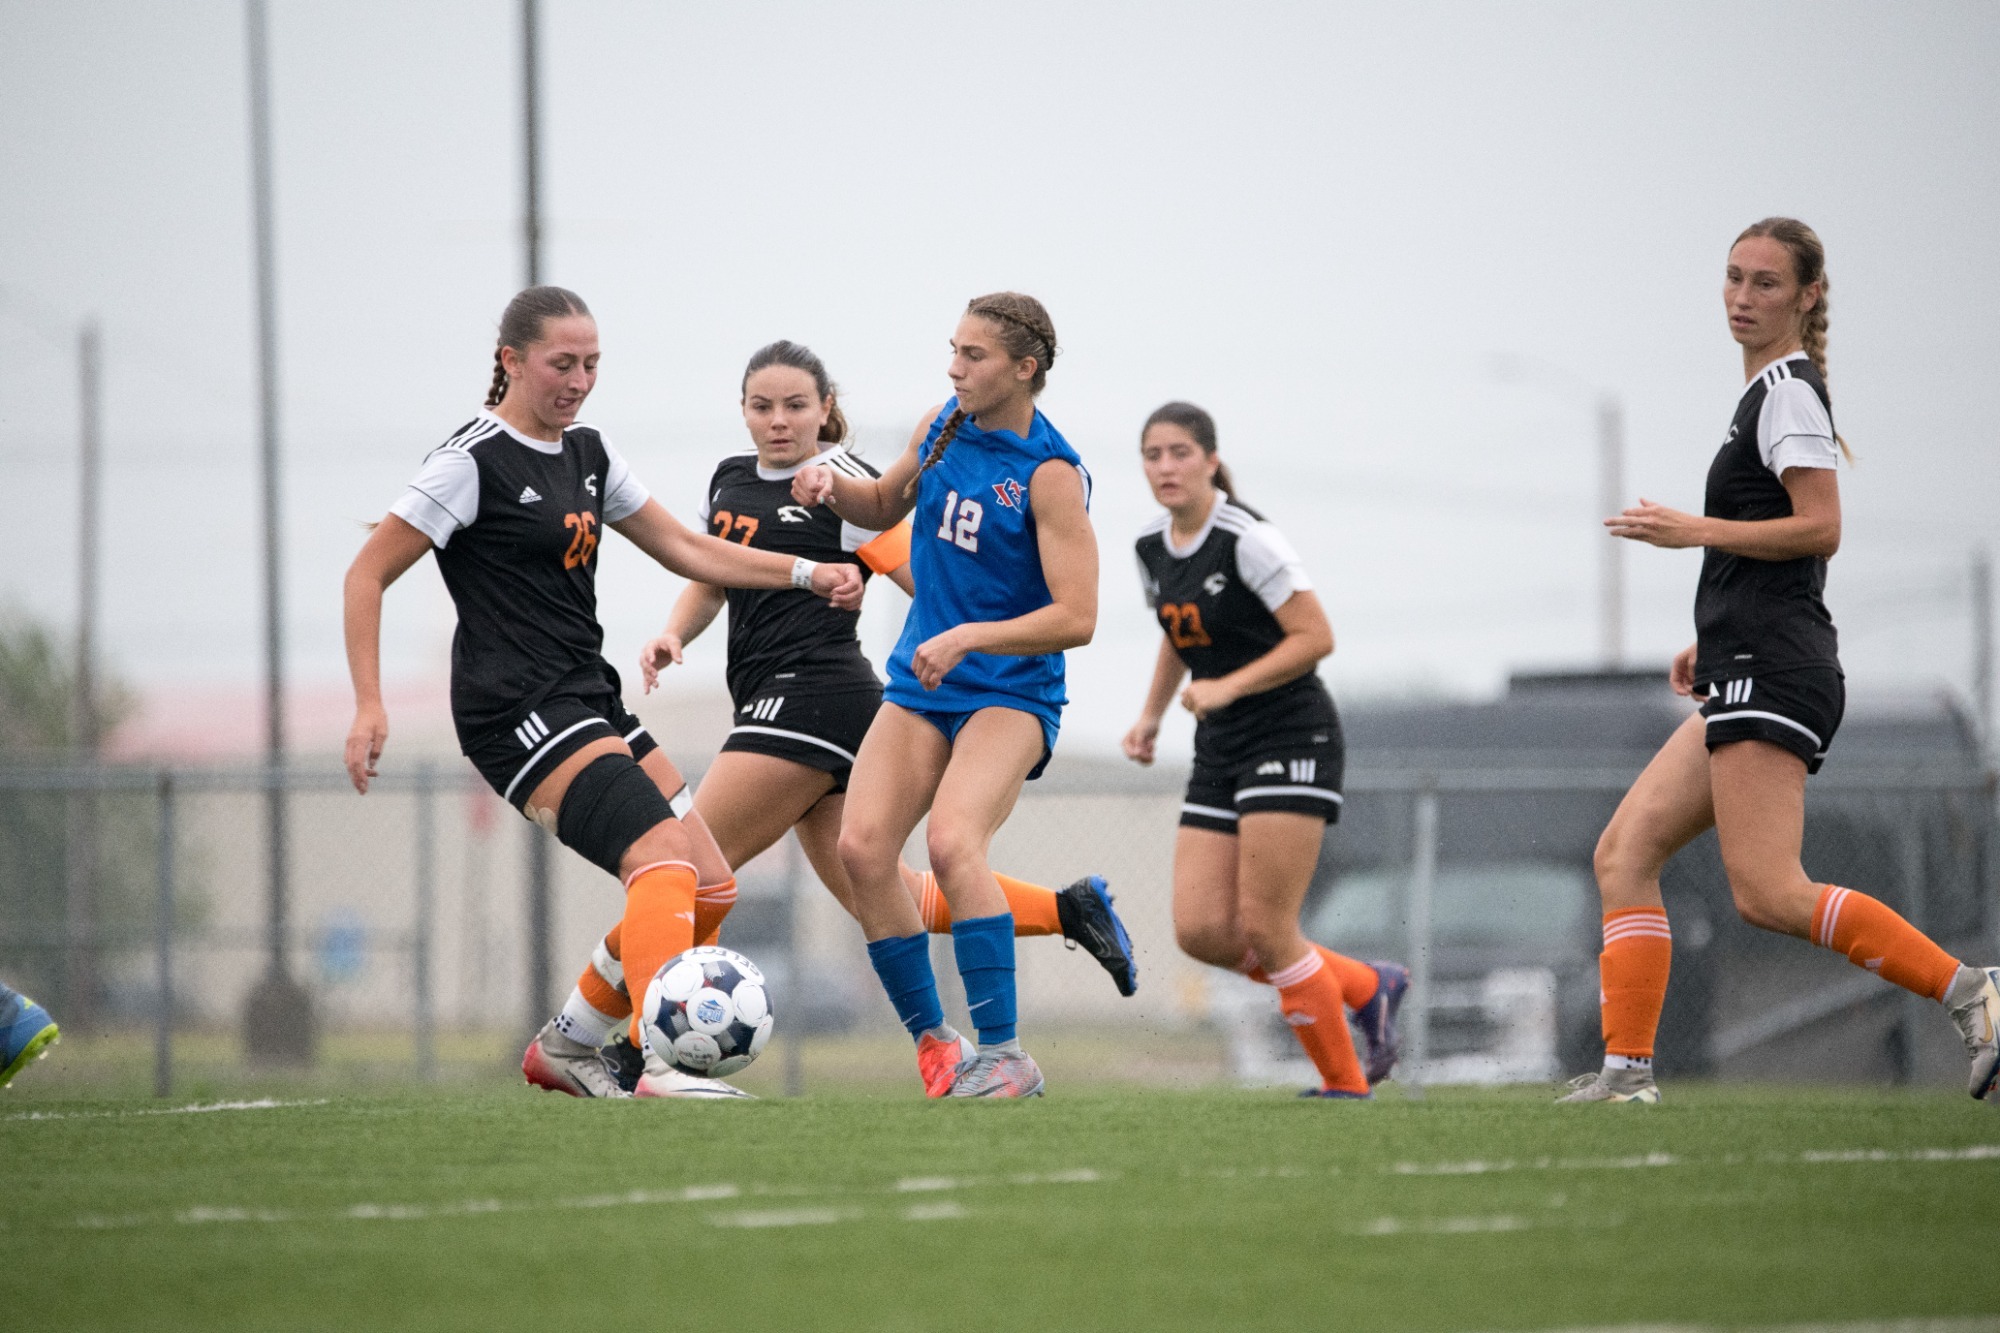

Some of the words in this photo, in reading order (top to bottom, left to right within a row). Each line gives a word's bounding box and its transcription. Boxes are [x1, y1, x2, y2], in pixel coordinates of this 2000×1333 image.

[563, 511, 597, 570] 26
[713, 509, 759, 547] 27
[937, 490, 983, 553] 12
[690, 947, 760, 977] SELECT
